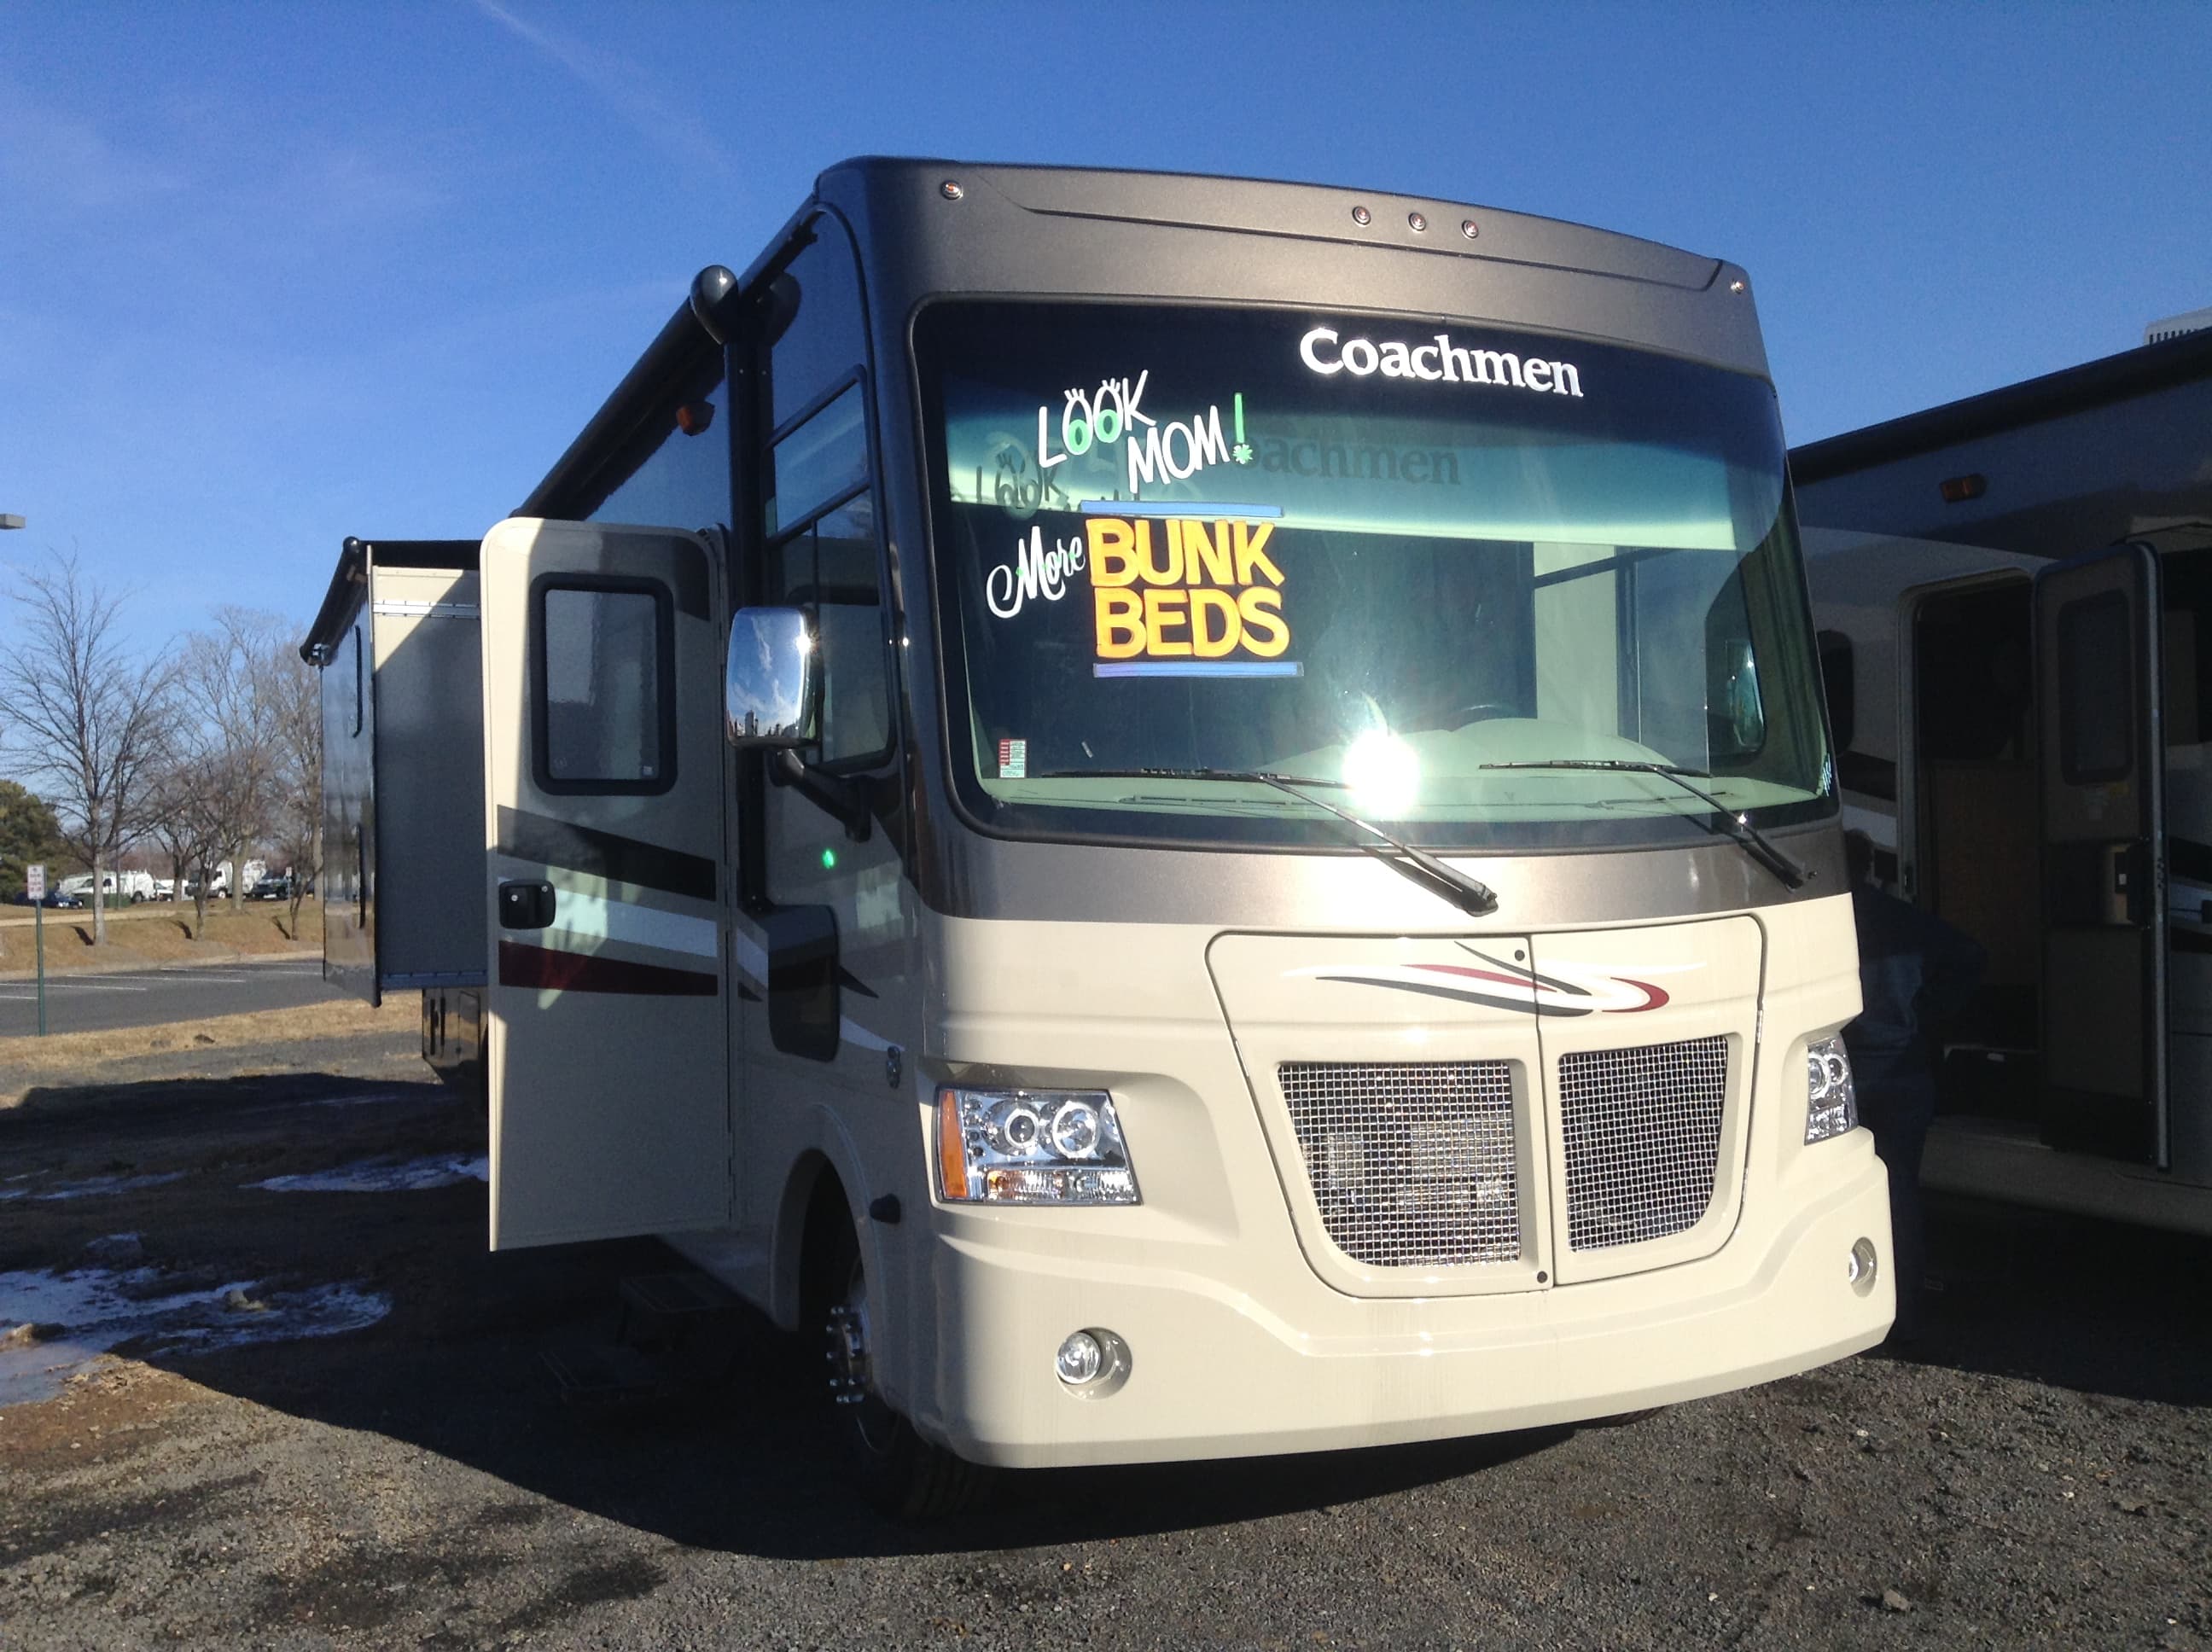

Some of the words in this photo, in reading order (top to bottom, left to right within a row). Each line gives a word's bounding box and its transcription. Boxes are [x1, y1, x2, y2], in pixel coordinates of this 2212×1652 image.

[1300, 327, 1584, 398] Coachmen
[1039, 369, 1156, 468] LOOK
[1128, 393, 1253, 494] MOM!
[987, 526, 1086, 619] More
[1086, 518, 1285, 587] BUNK
[1094, 586, 1290, 658] BEDS
